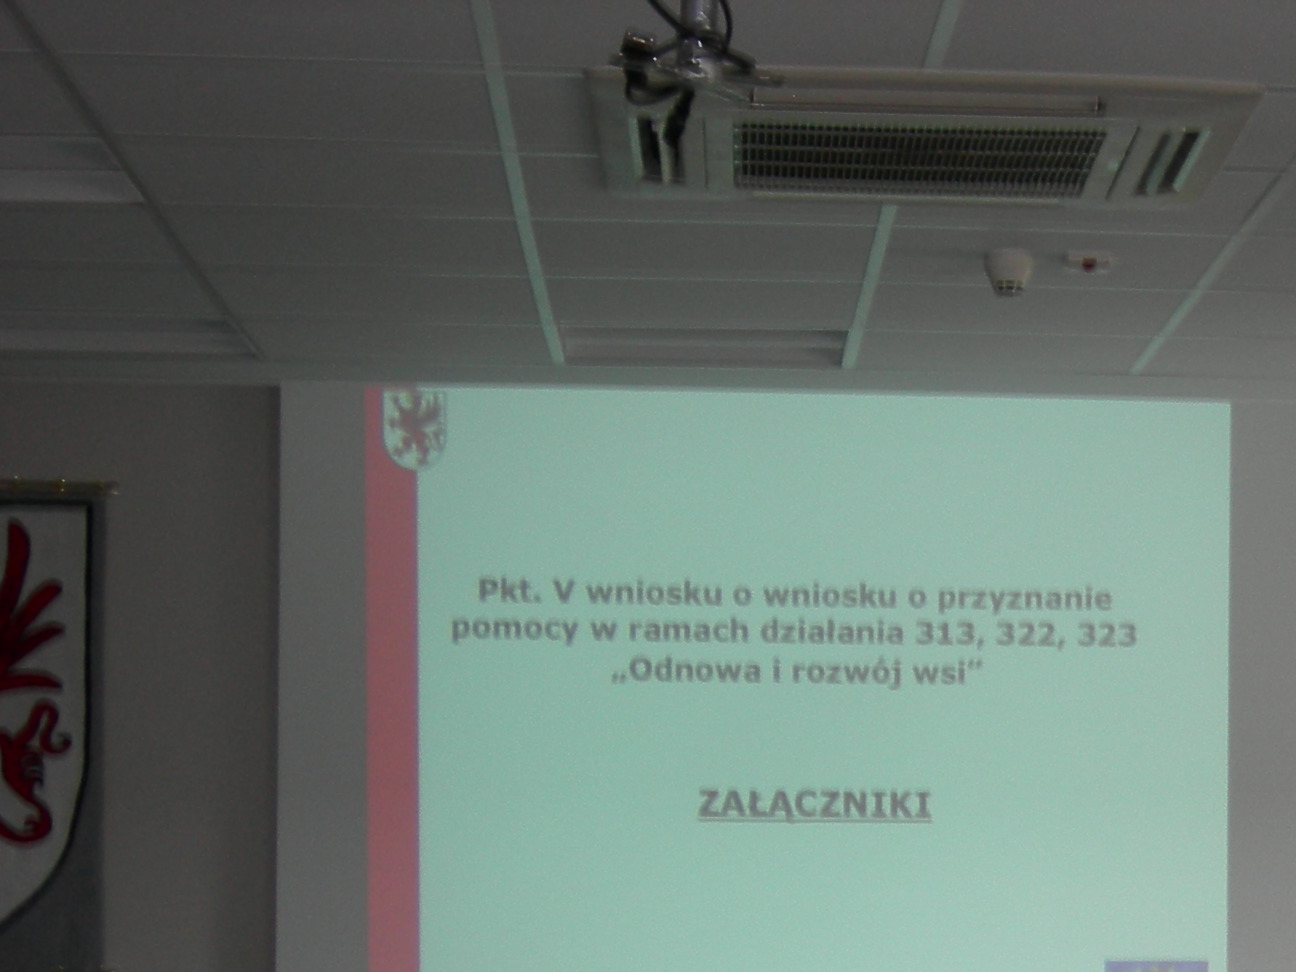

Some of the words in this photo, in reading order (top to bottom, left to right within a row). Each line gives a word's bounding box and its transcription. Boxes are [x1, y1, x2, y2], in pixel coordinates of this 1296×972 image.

[477, 577, 541, 604] Pkt.
[552, 579, 575, 604] V
[586, 578, 723, 606] wniosku
[733, 586, 752, 606] o
[763, 580, 898, 610] wniosku
[908, 589, 927, 610] o
[938, 585, 1113, 616] przyznanie
[451, 617, 579, 645] pomocy
[591, 618, 617, 641] w
[629, 617, 749, 643] ramach
[760, 618, 905, 645] działania
[915, 622, 985, 649] 313,
[995, 622, 1066, 649] 322,
[1078, 623, 1139, 648] 323
[771, 657, 782, 684] i
[792, 656, 902, 688] rozwój
[698, 788, 933, 824] ZAŁĄCZNIKI
